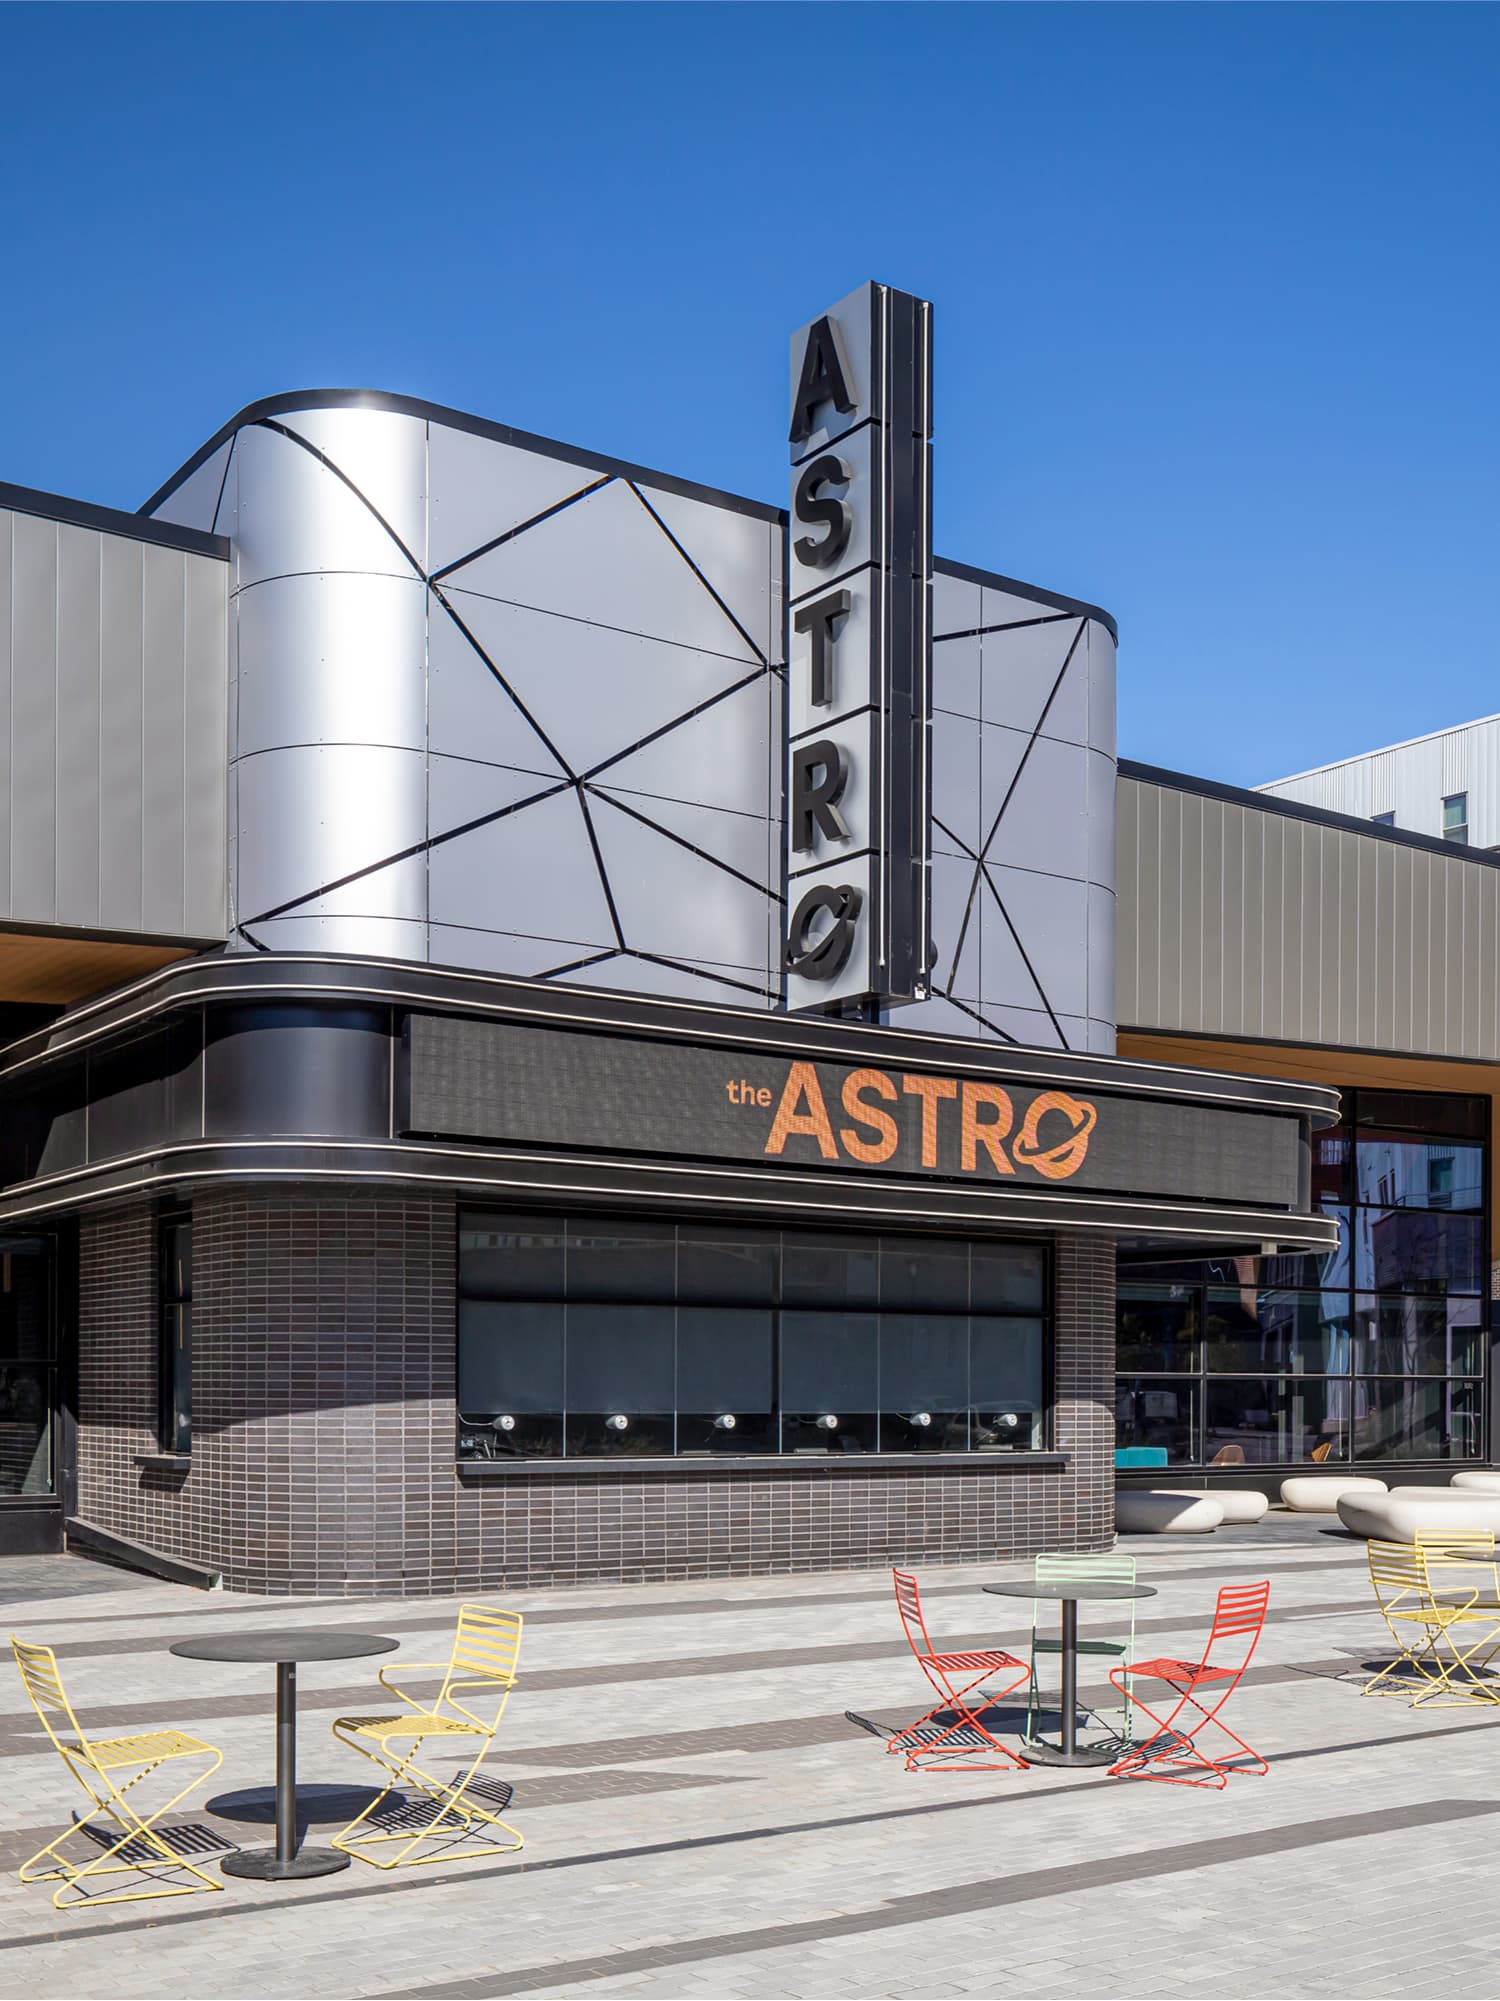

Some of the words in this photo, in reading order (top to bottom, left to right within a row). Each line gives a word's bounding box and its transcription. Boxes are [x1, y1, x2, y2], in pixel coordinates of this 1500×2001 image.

[786, 315, 860, 982] ASTRO
[726, 1079, 772, 1107] the
[764, 1061, 1097, 1180] ASTRO
